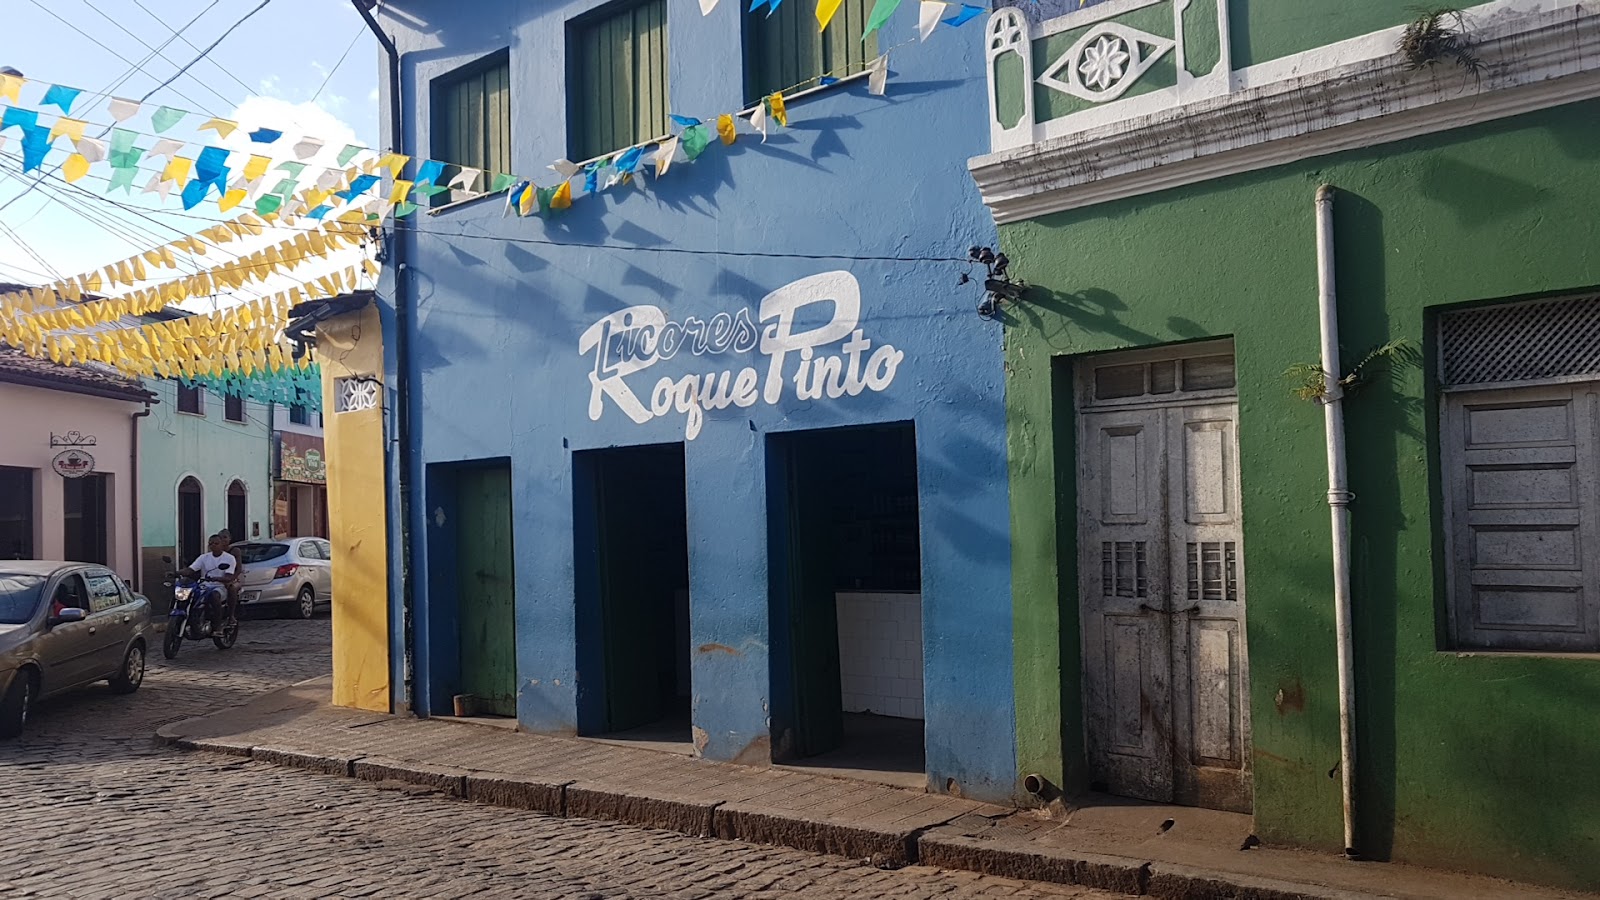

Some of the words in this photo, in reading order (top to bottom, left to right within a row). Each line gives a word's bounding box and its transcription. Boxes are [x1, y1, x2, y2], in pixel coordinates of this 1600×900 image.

[579, 304, 758, 441] Roque
[759, 270, 904, 405] Pinto
[595, 306, 757, 374] Licores
